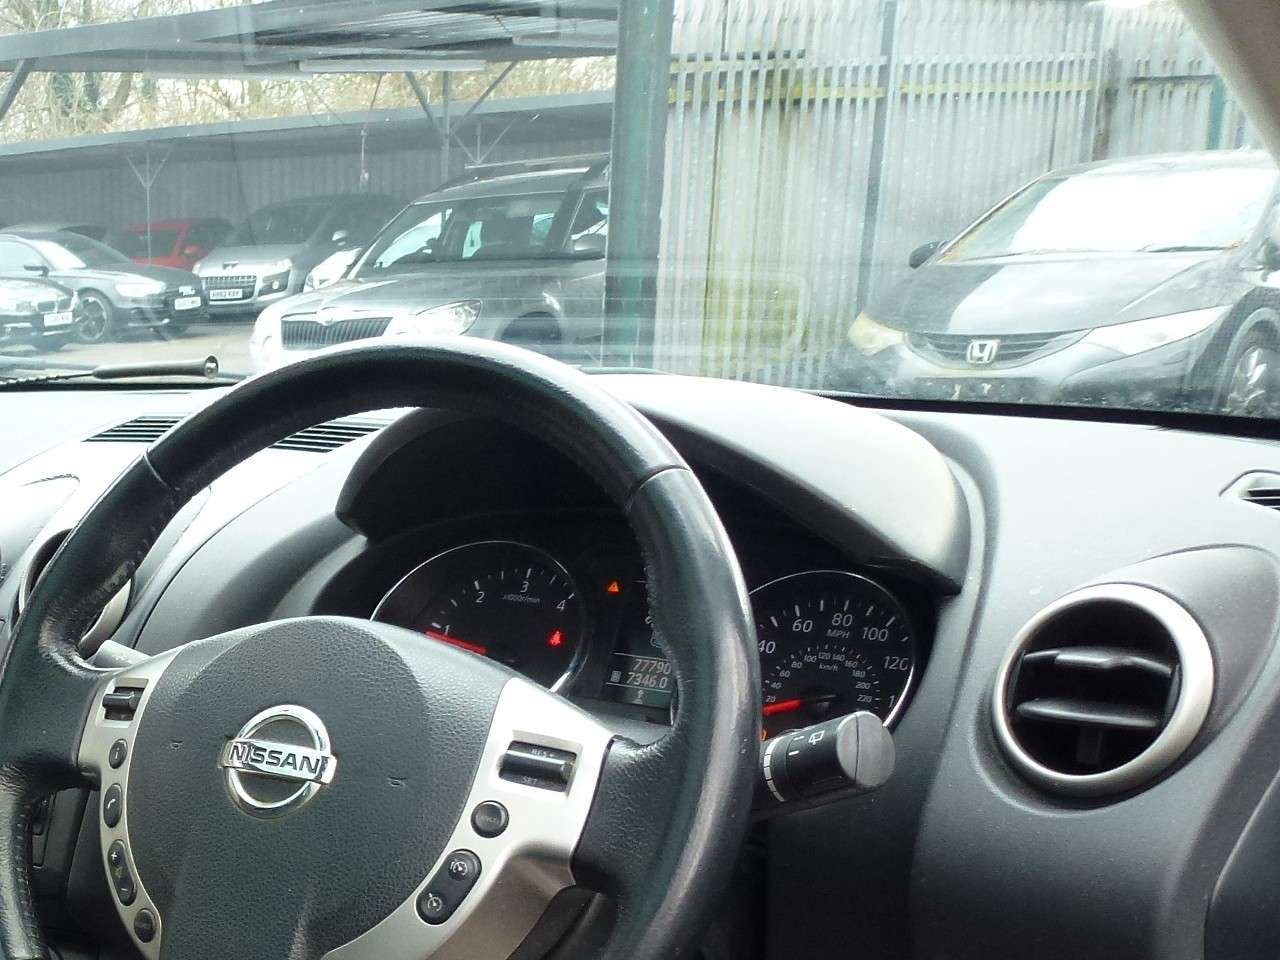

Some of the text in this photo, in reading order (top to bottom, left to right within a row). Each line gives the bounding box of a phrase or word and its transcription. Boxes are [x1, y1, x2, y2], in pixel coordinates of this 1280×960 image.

[520, 581, 529, 593] 3
[475, 591, 485, 603] 2
[556, 600, 566, 611] 4
[792, 619, 813, 633] 60
[831, 613, 853, 627] 80
[443, 624, 451, 635] 1
[826, 629, 850, 639] MPH
[862, 627, 889, 642] 100
[758, 640, 776, 653] 40
[791, 661, 802, 669] 80
[804, 655, 817, 663] 100
[633, 659, 672, 675] 77790
[779, 670, 790, 678] 60
[626, 672, 668, 689] 7346.0
[229, 744, 321, 775] NISSAN
